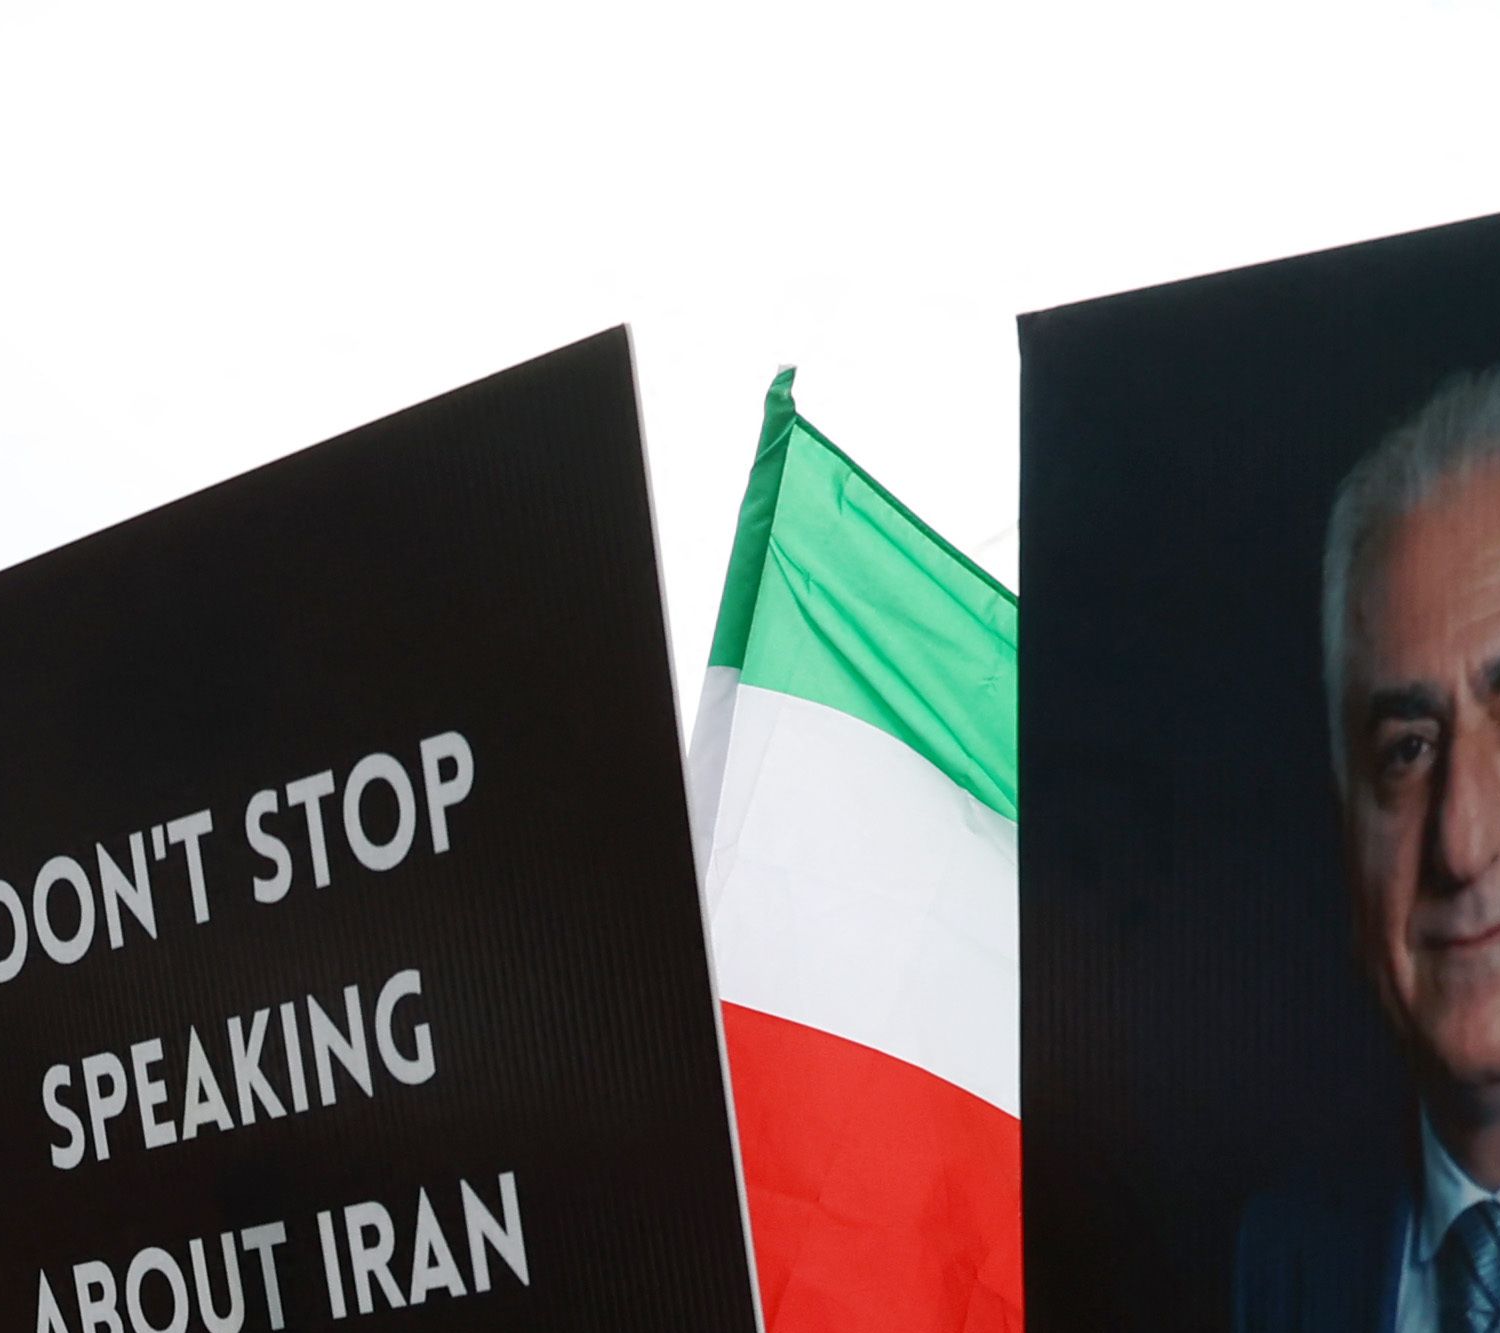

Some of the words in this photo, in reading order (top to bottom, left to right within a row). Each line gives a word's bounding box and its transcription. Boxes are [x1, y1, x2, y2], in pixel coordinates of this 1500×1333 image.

[245, 731, 475, 905] STOP
[42, 969, 437, 1170] SPEAKING
[316, 1171, 530, 1320] IRAN
